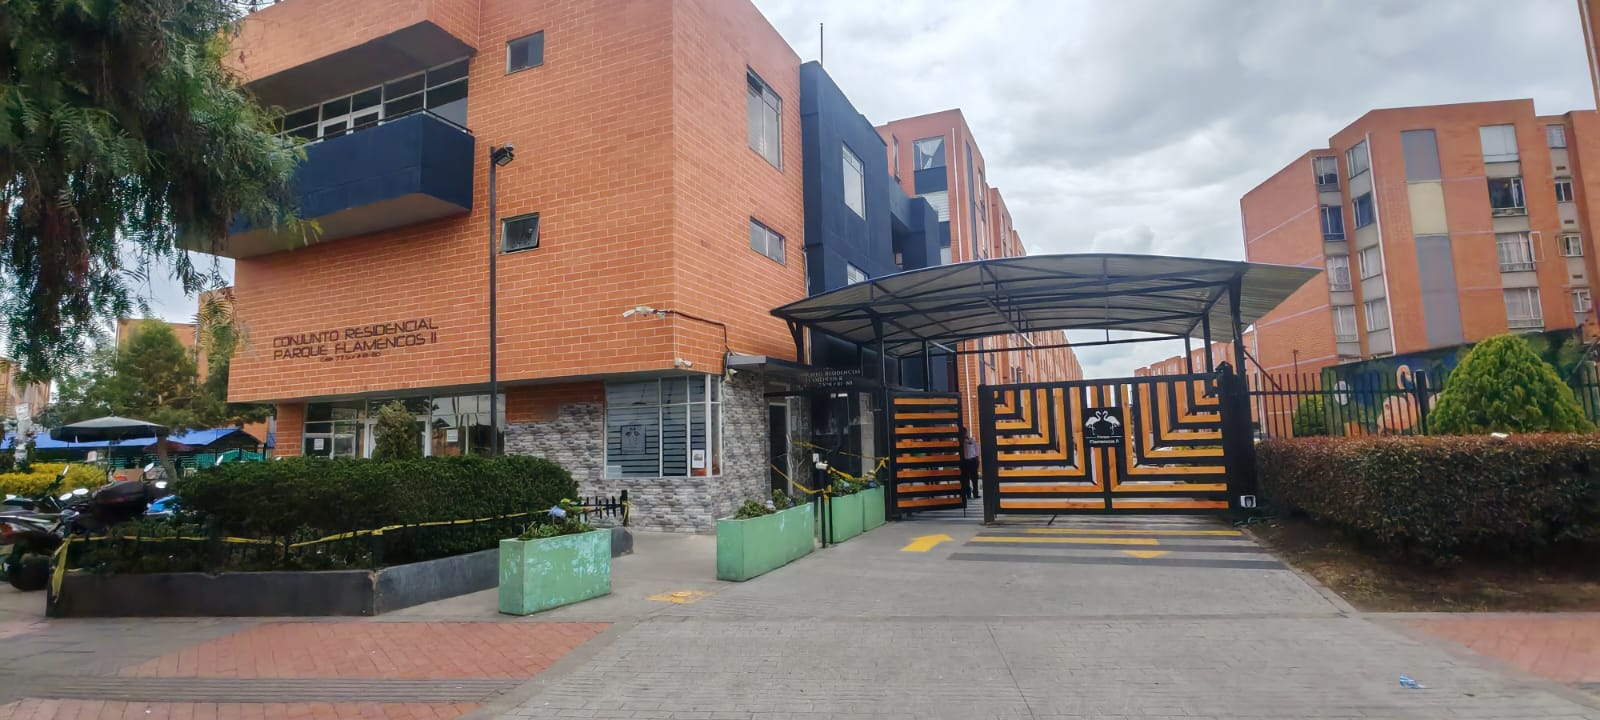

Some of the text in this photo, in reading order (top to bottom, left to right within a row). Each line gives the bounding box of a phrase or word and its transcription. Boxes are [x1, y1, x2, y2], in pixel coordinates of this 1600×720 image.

[273, 318, 439, 348] CONJUNTO RESIDENCIAL
[273, 332, 437, 361] PARQUE FLAMENCOS II
